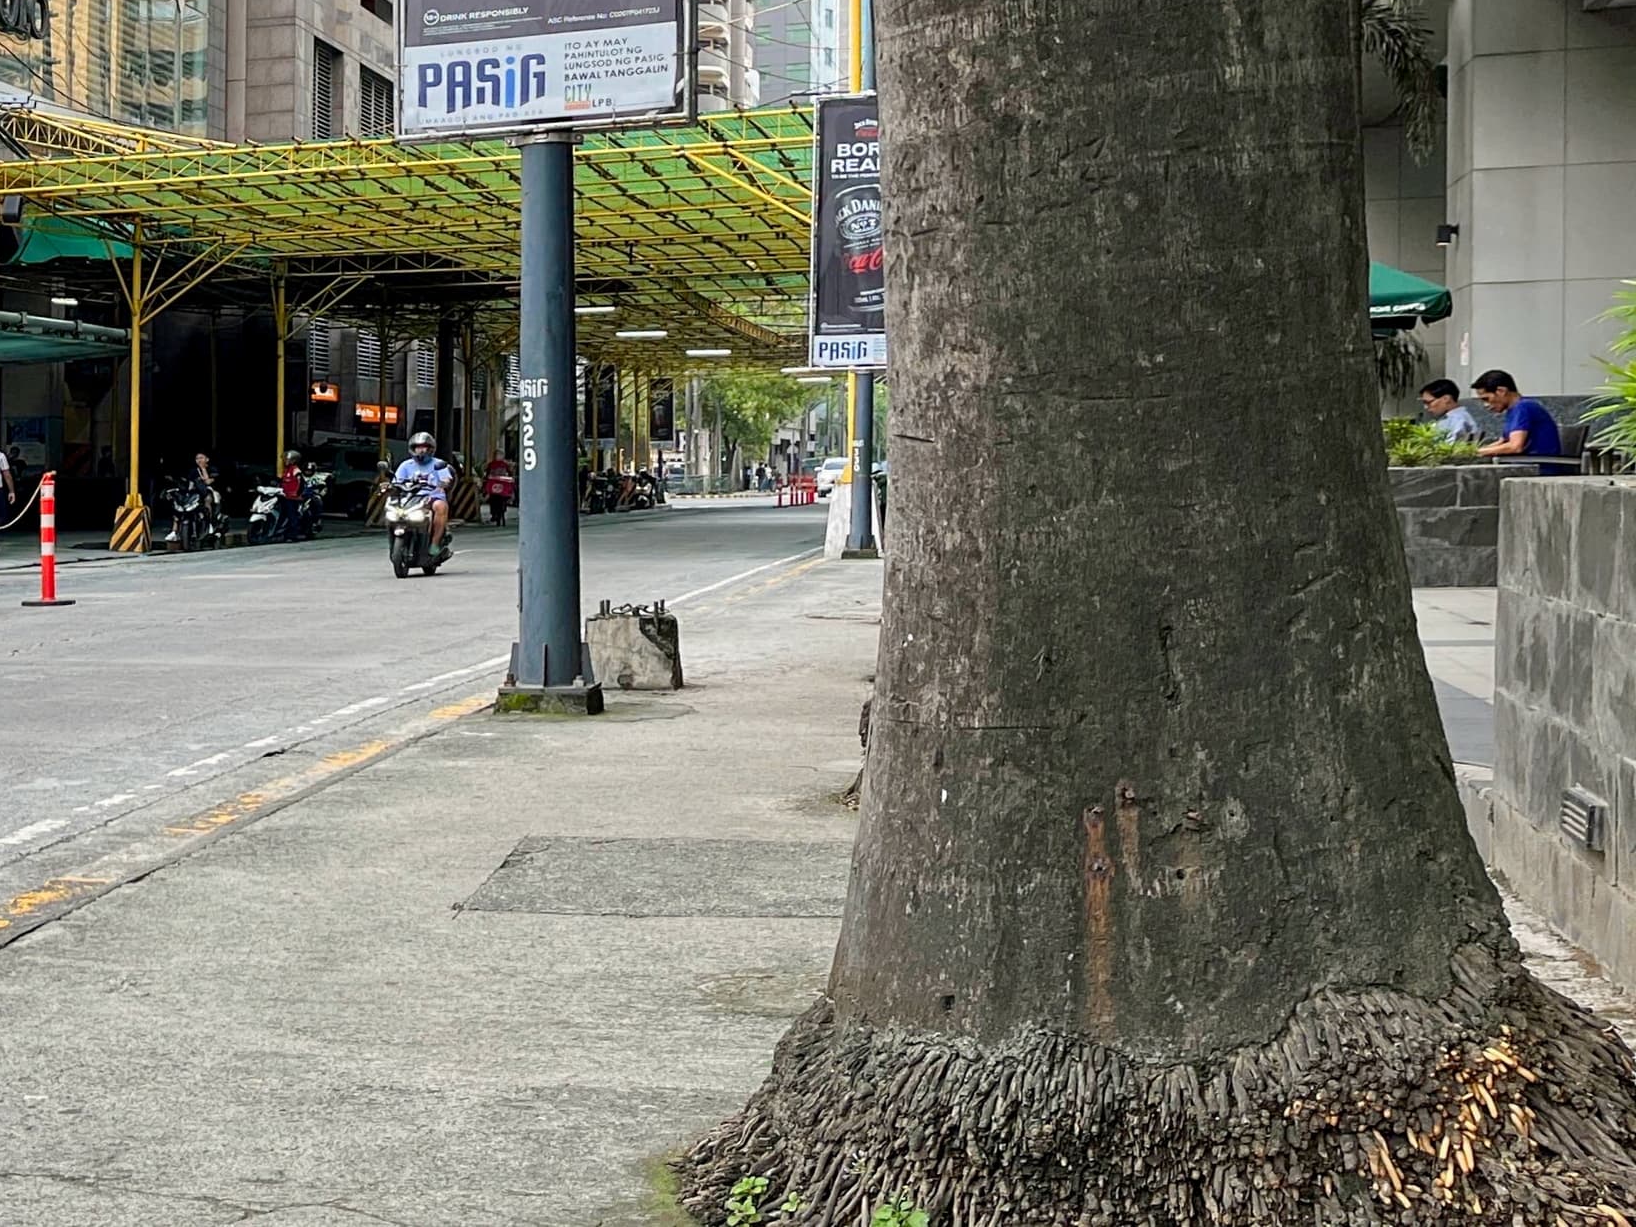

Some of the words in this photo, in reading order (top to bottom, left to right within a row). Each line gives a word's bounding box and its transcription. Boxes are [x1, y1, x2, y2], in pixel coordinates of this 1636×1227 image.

[440, 12, 467, 22] DRINK
[469, 7, 530, 20] RESPONSIBLY
[564, 41, 582, 51] ITO
[585, 40, 600, 50] AY
[604, 37, 629, 47] MAY
[564, 48, 624, 61] PAHINTULOT
[626, 45, 644, 55] NG
[564, 59, 612, 71] LUNGSOD
[615, 57, 632, 66] NG
[634, 53, 665, 64] PASIG
[564, 71, 602, 82] BAWAL
[604, 63, 669, 79] TANGGALIN
[564, 83, 593, 103] CITY
[592, 98, 613, 108] LPB
[836, 142, 881, 157] BOR
[830, 157, 881, 173] REA
